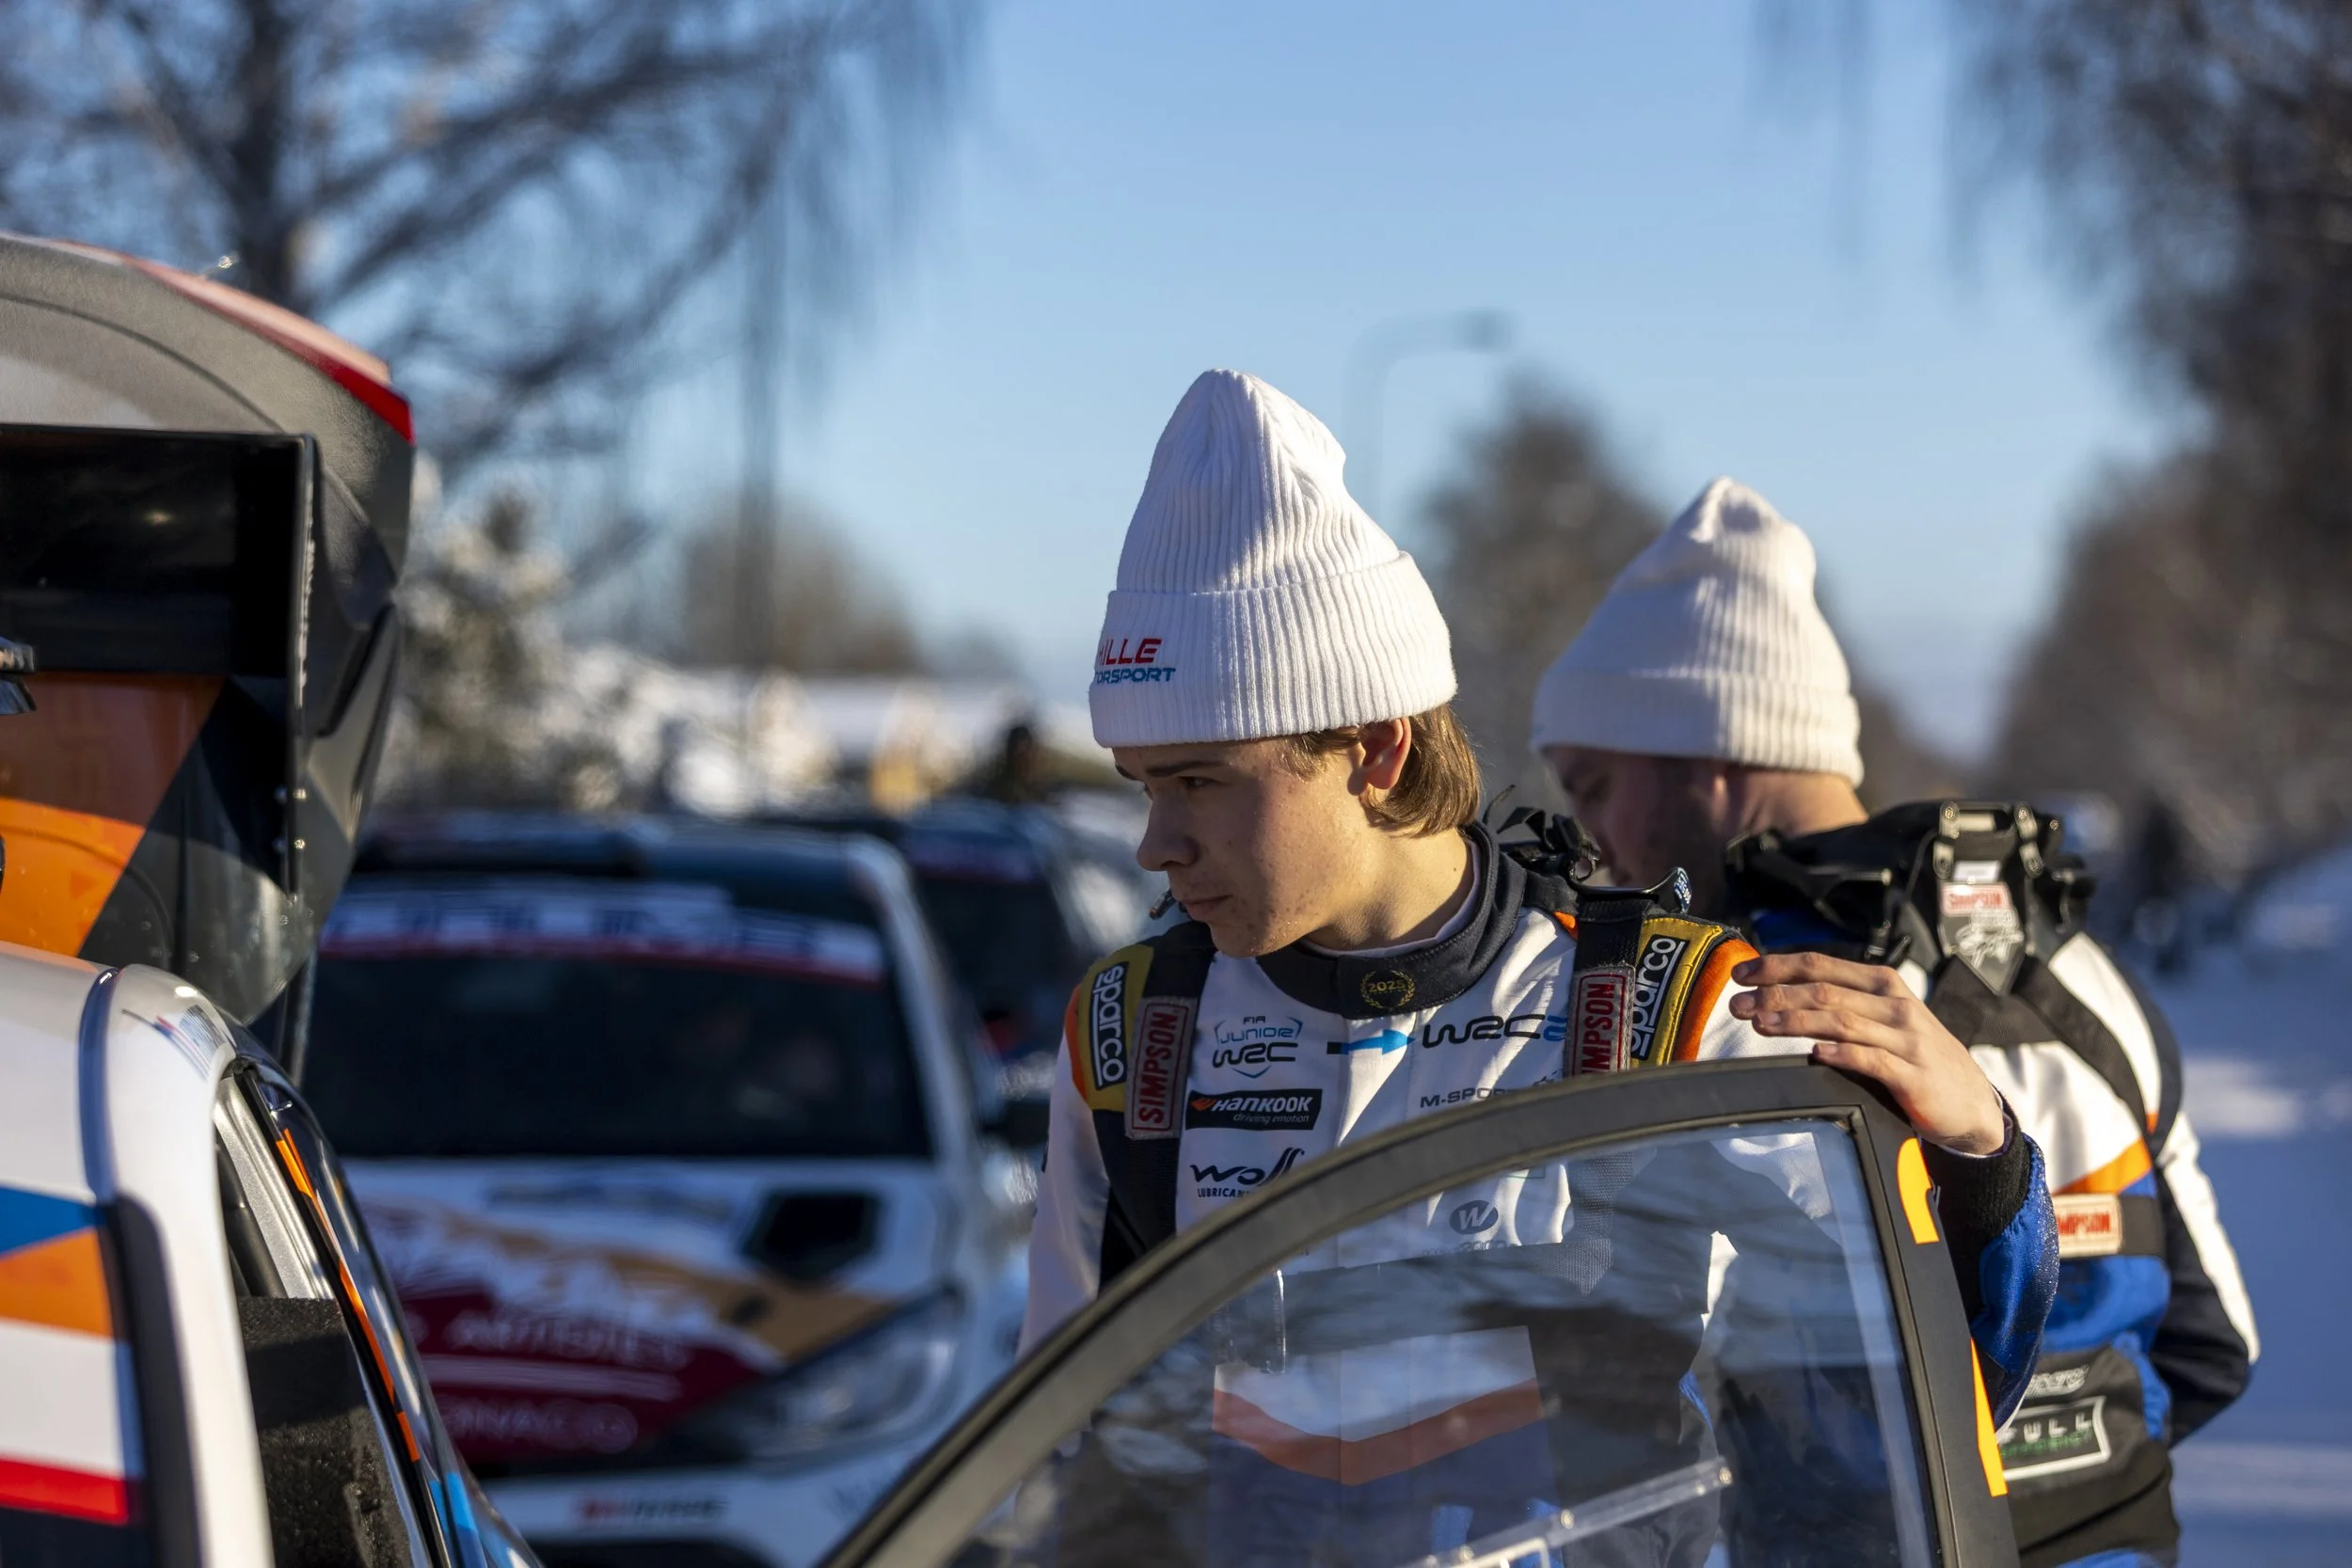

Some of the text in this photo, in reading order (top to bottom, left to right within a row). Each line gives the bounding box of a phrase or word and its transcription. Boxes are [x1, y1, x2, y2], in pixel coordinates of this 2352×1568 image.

[1095, 667, 1177, 684] ORSPORT
[1368, 979, 1406, 993] 2025
[1092, 964, 1125, 1083] sparco
[1243, 1015, 1267, 1025] FIA
[1581, 983, 1616, 1075] IMPSON
[1220, 1026, 1295, 1044] JUNIOR
[1212, 1042, 1298, 1069] WRC
[1137, 1011, 1180, 1125] SIMPSON
[1420, 1086, 1510, 1108] M-SPO
[1232, 1113, 1311, 1125] driving emotion
